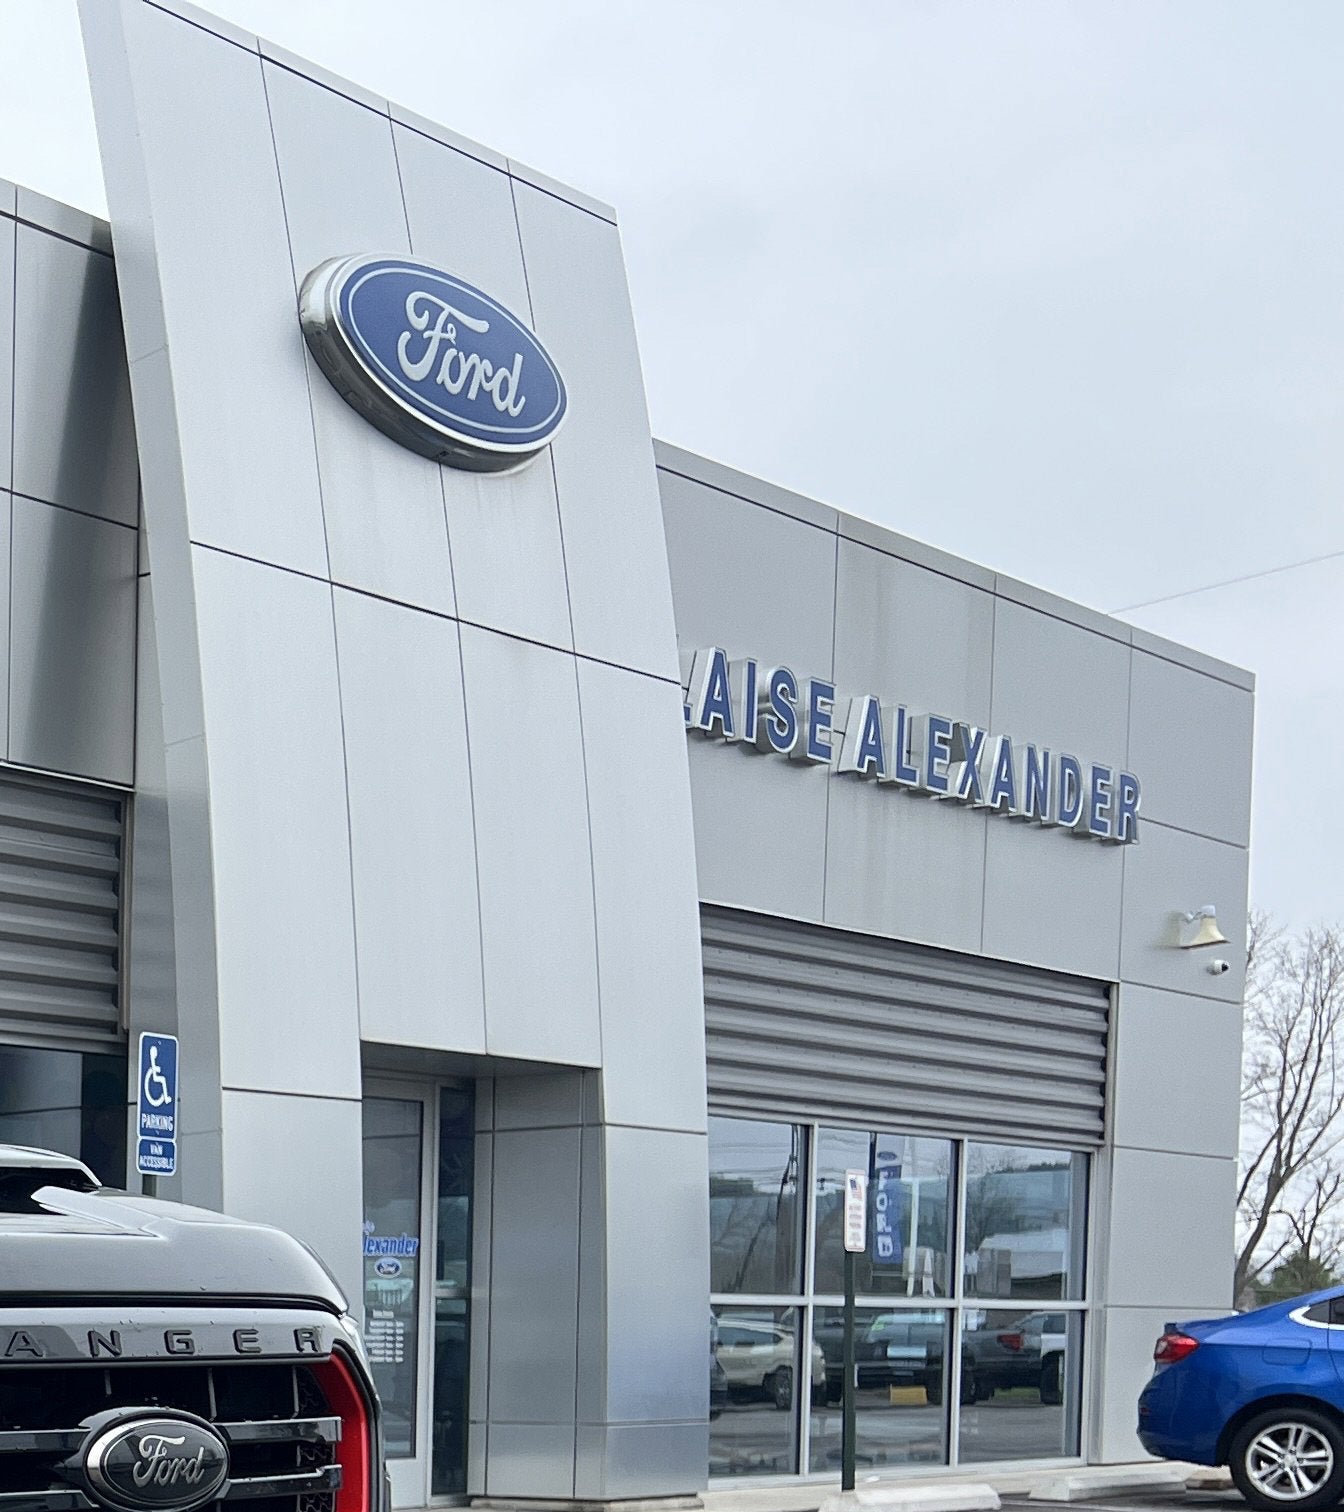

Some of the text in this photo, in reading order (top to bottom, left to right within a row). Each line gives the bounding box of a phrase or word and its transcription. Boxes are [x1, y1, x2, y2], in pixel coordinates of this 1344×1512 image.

[397, 291, 526, 417] Ford
[854, 694, 1140, 845] ALEXANDER
[141, 1112, 174, 1132] PARKING
[139, 1157, 174, 1170] ACCESSIBLE
[131, 1434, 205, 1488] Ford
